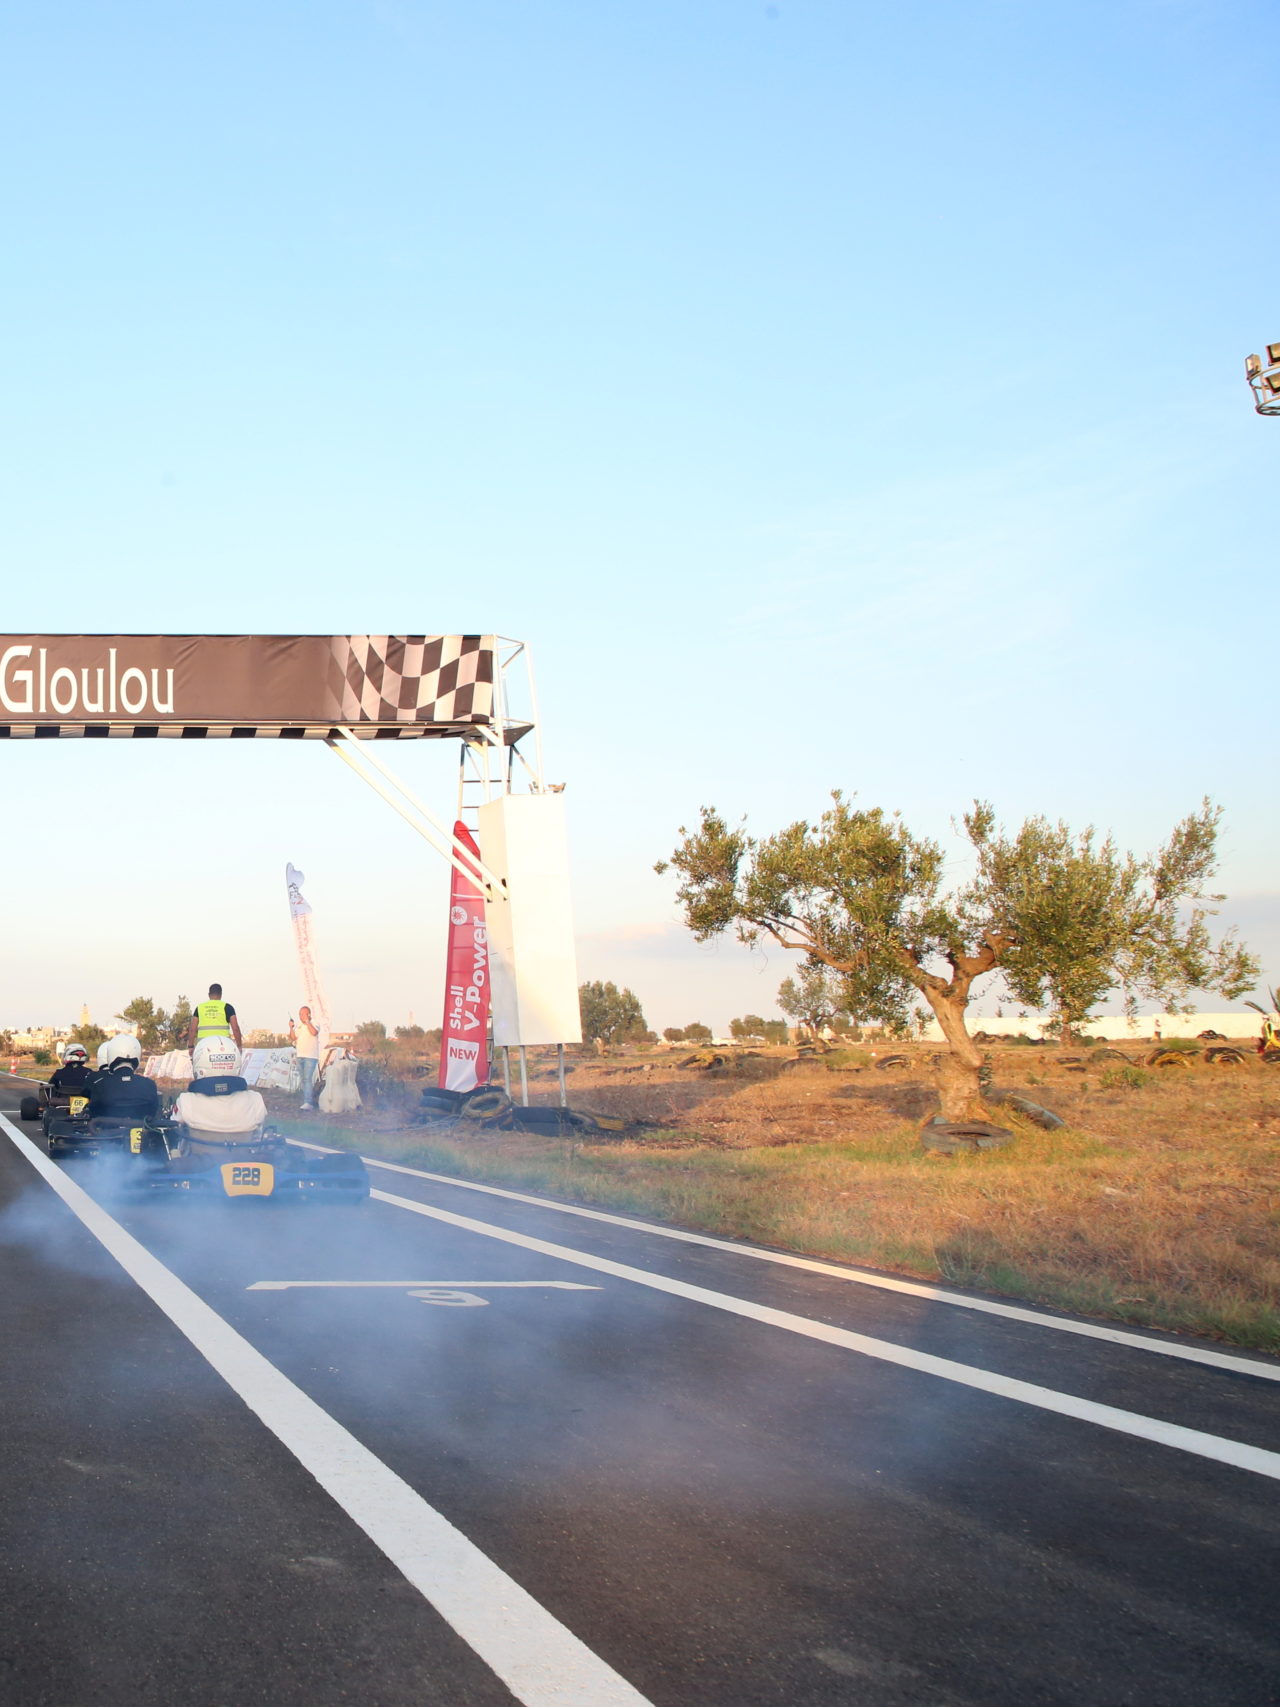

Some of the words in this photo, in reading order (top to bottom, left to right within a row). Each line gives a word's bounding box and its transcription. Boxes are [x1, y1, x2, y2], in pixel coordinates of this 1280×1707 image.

[463, 915, 488, 1031] V-Power
[449, 985, 465, 1030] Shell
[449, 1046, 477, 1061] NEW
[74, 1099, 84, 1107] 66
[232, 1167, 260, 1186] 228
[406, 1289, 491, 1307] 9
